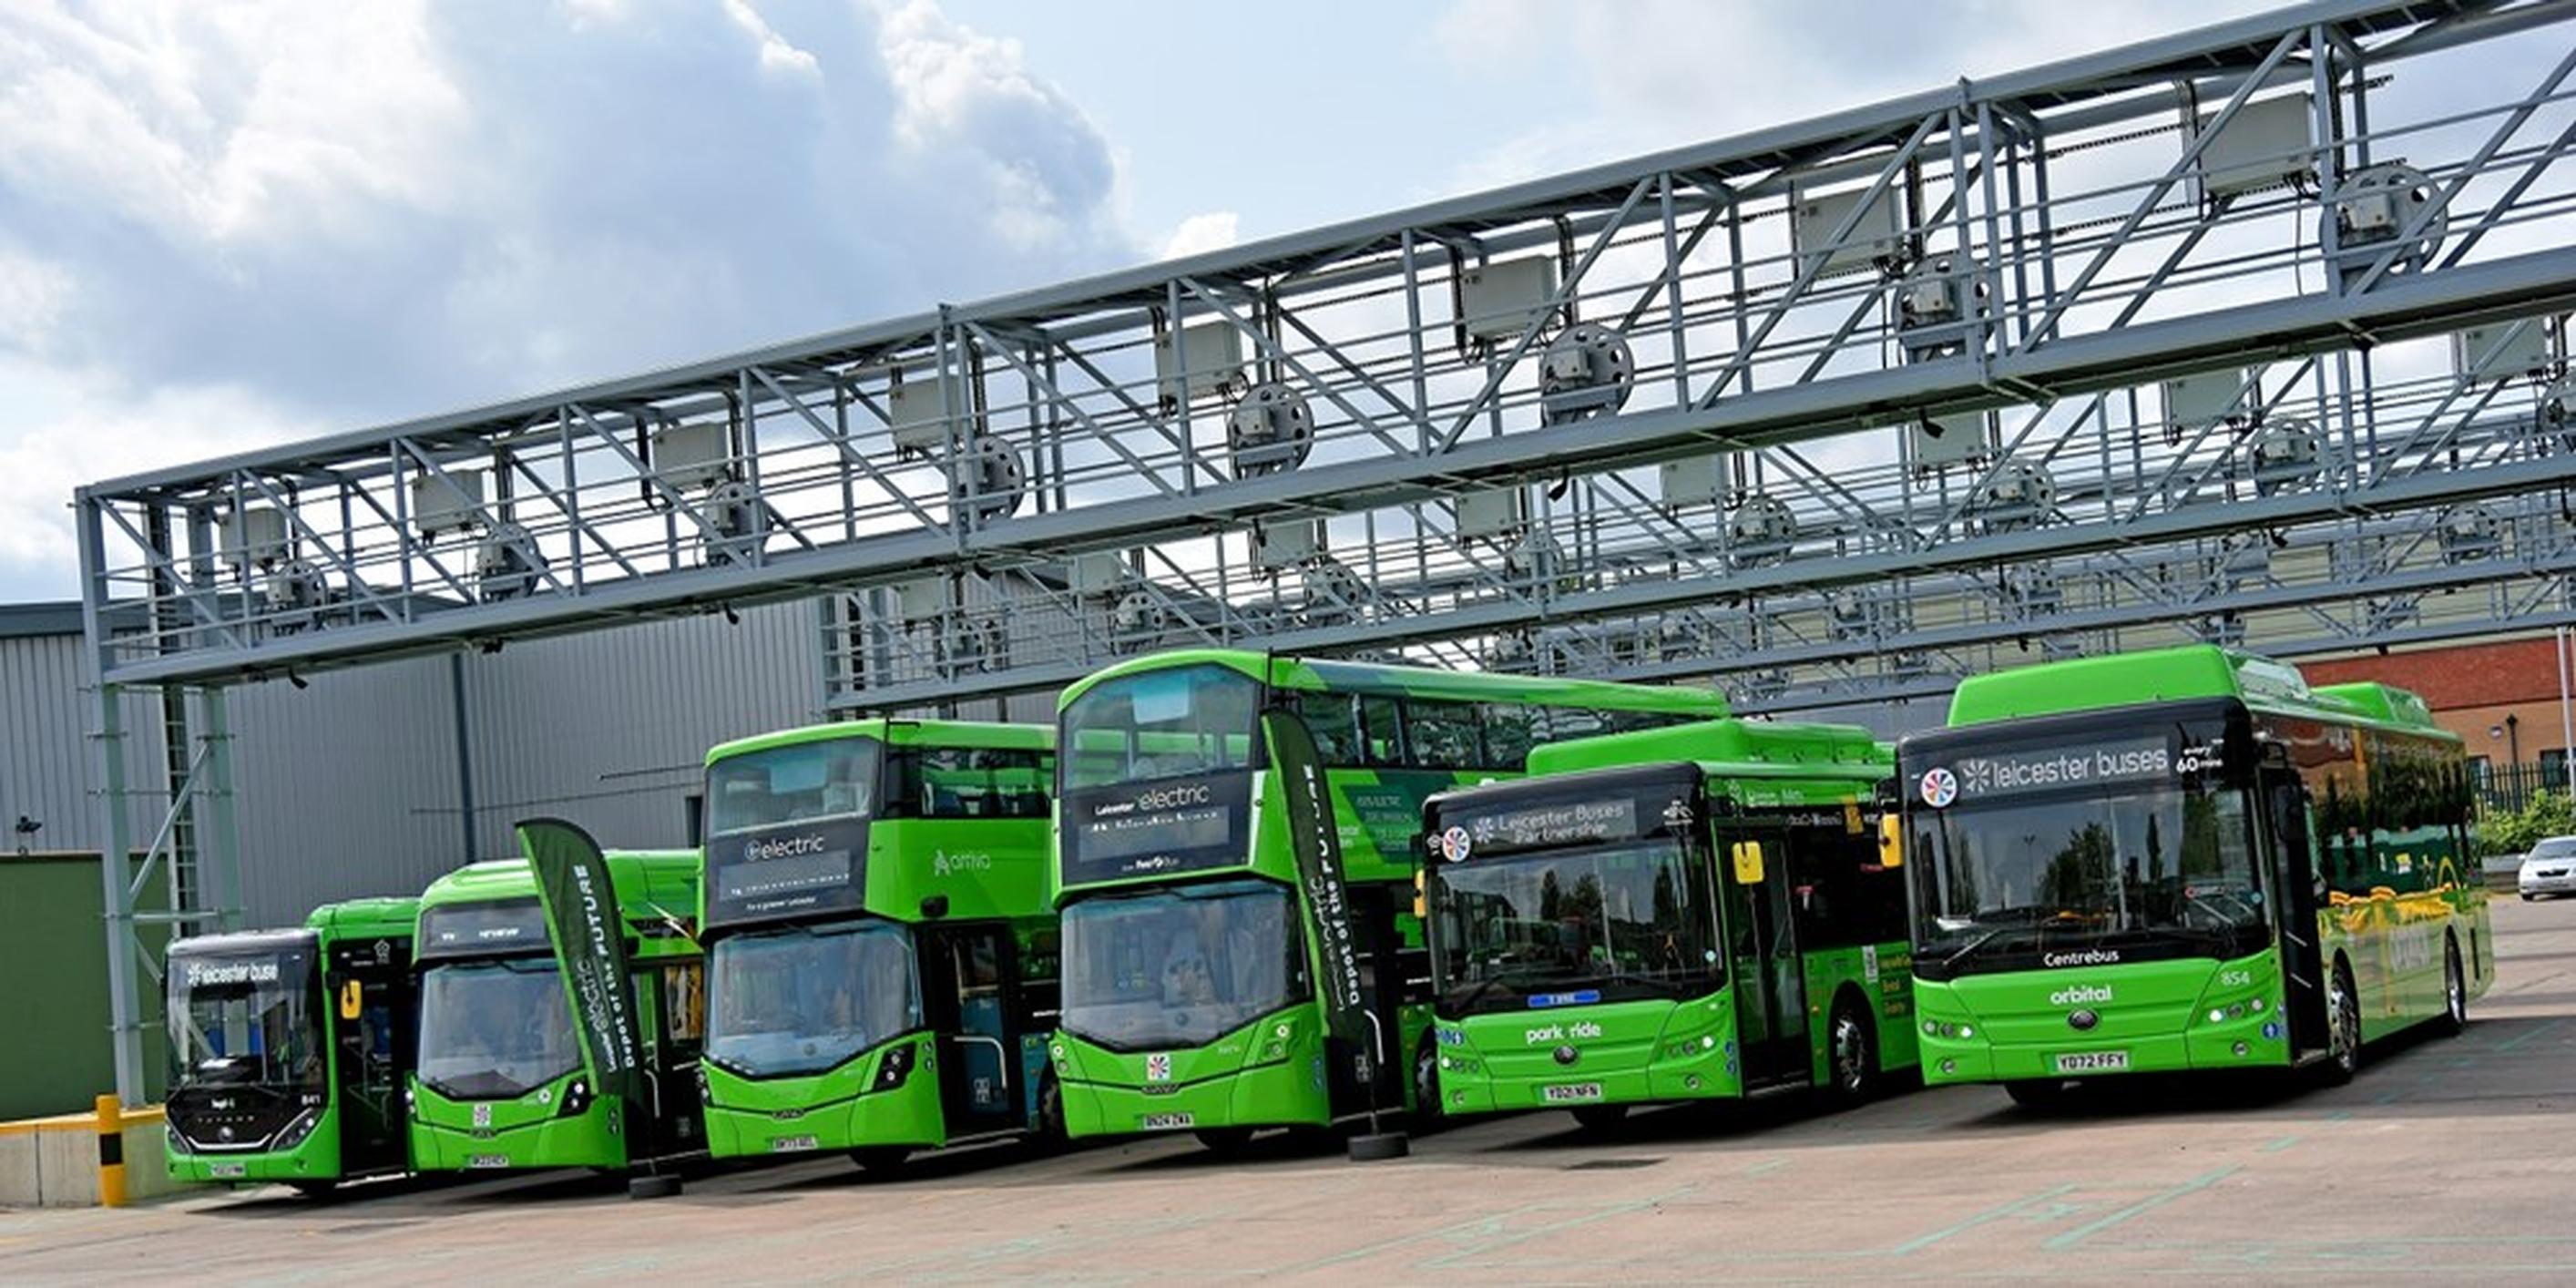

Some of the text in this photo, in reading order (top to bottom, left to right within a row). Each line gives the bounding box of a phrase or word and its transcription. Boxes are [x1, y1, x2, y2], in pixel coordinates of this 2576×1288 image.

[1993, 749, 2169, 788] leicester buses
[2175, 756, 2199, 774] 60
[1139, 784, 1211, 812] electric
[1498, 804, 1626, 831] Leicester Buses
[1514, 822, 1609, 845] Partnership
[762, 834, 824, 859] electric
[1327, 880, 1342, 914] the
[1333, 919, 1348, 939] of
[574, 864, 636, 1068] Depot of the FUTURE
[2043, 949, 2120, 966] Centrebus
[1341, 945, 1360, 1005] Depot
[2221, 970, 2250, 986] 854
[577, 960, 609, 1033] electric
[2050, 984, 2112, 1005] orbital
[1526, 1021, 1601, 1045] park ride
